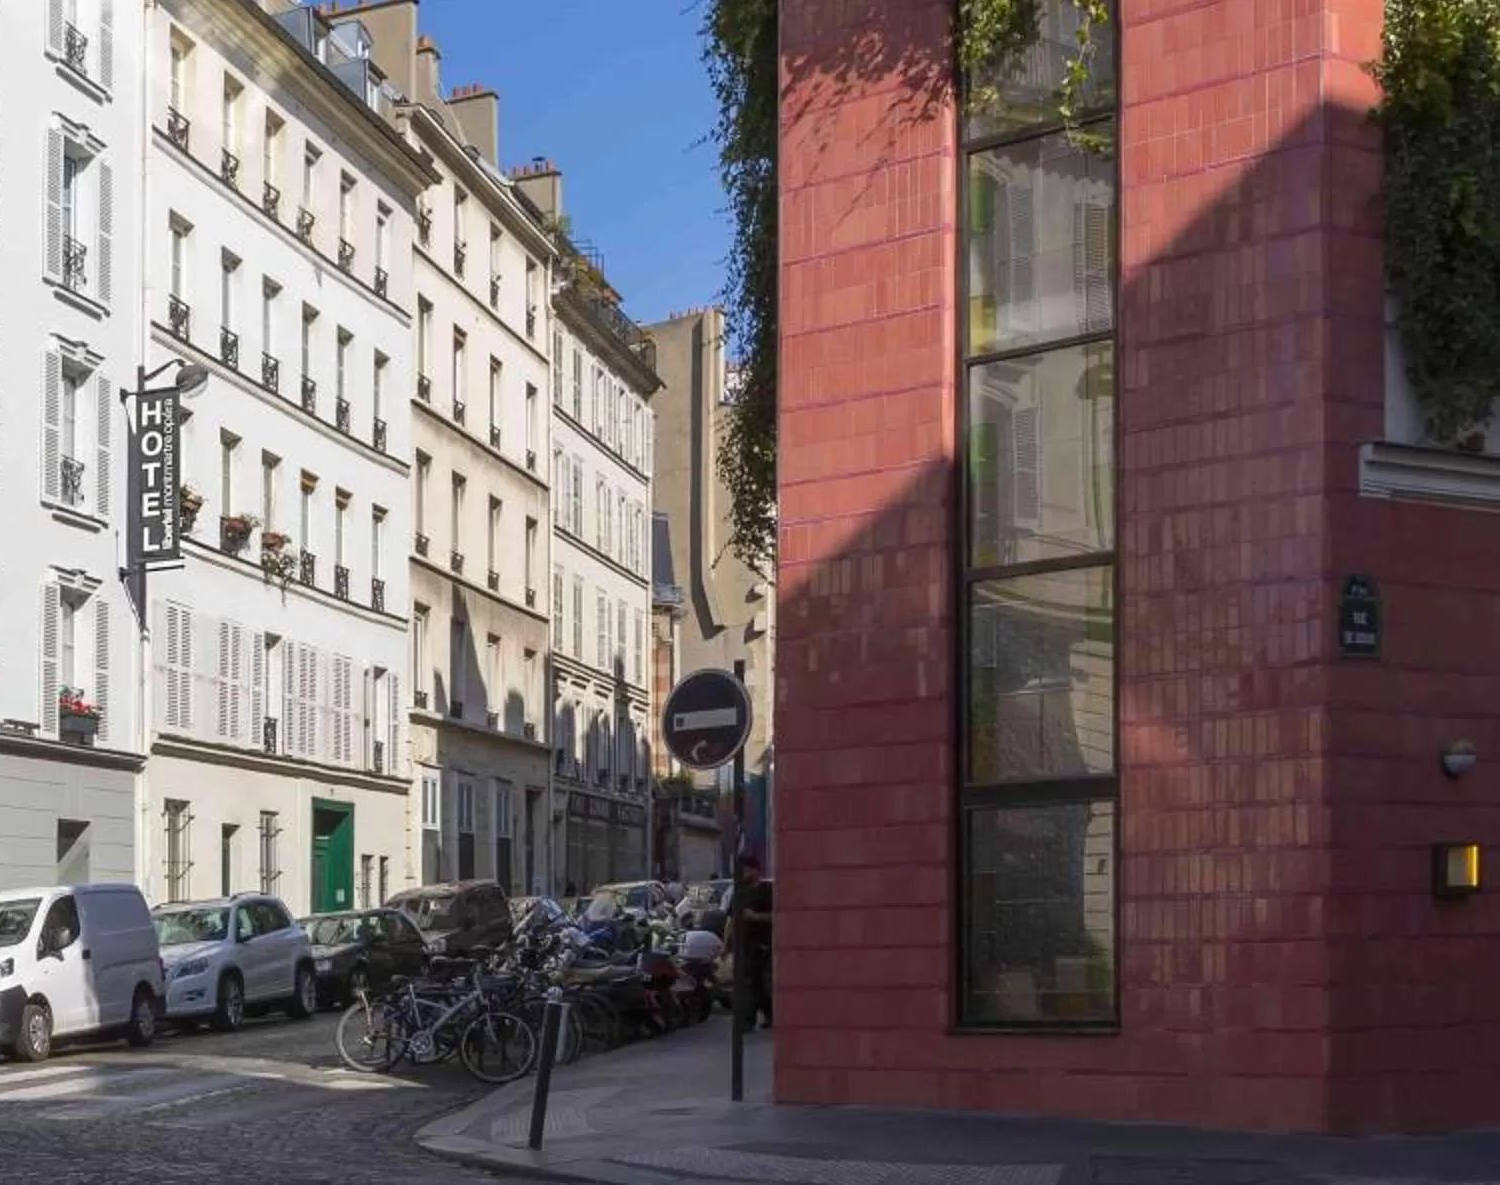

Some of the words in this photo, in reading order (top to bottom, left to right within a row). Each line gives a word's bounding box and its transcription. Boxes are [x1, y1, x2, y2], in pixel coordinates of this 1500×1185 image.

[141, 399, 162, 552] HOTEL
[163, 435, 173, 507] montmartre
[162, 509, 173, 550] libertel
